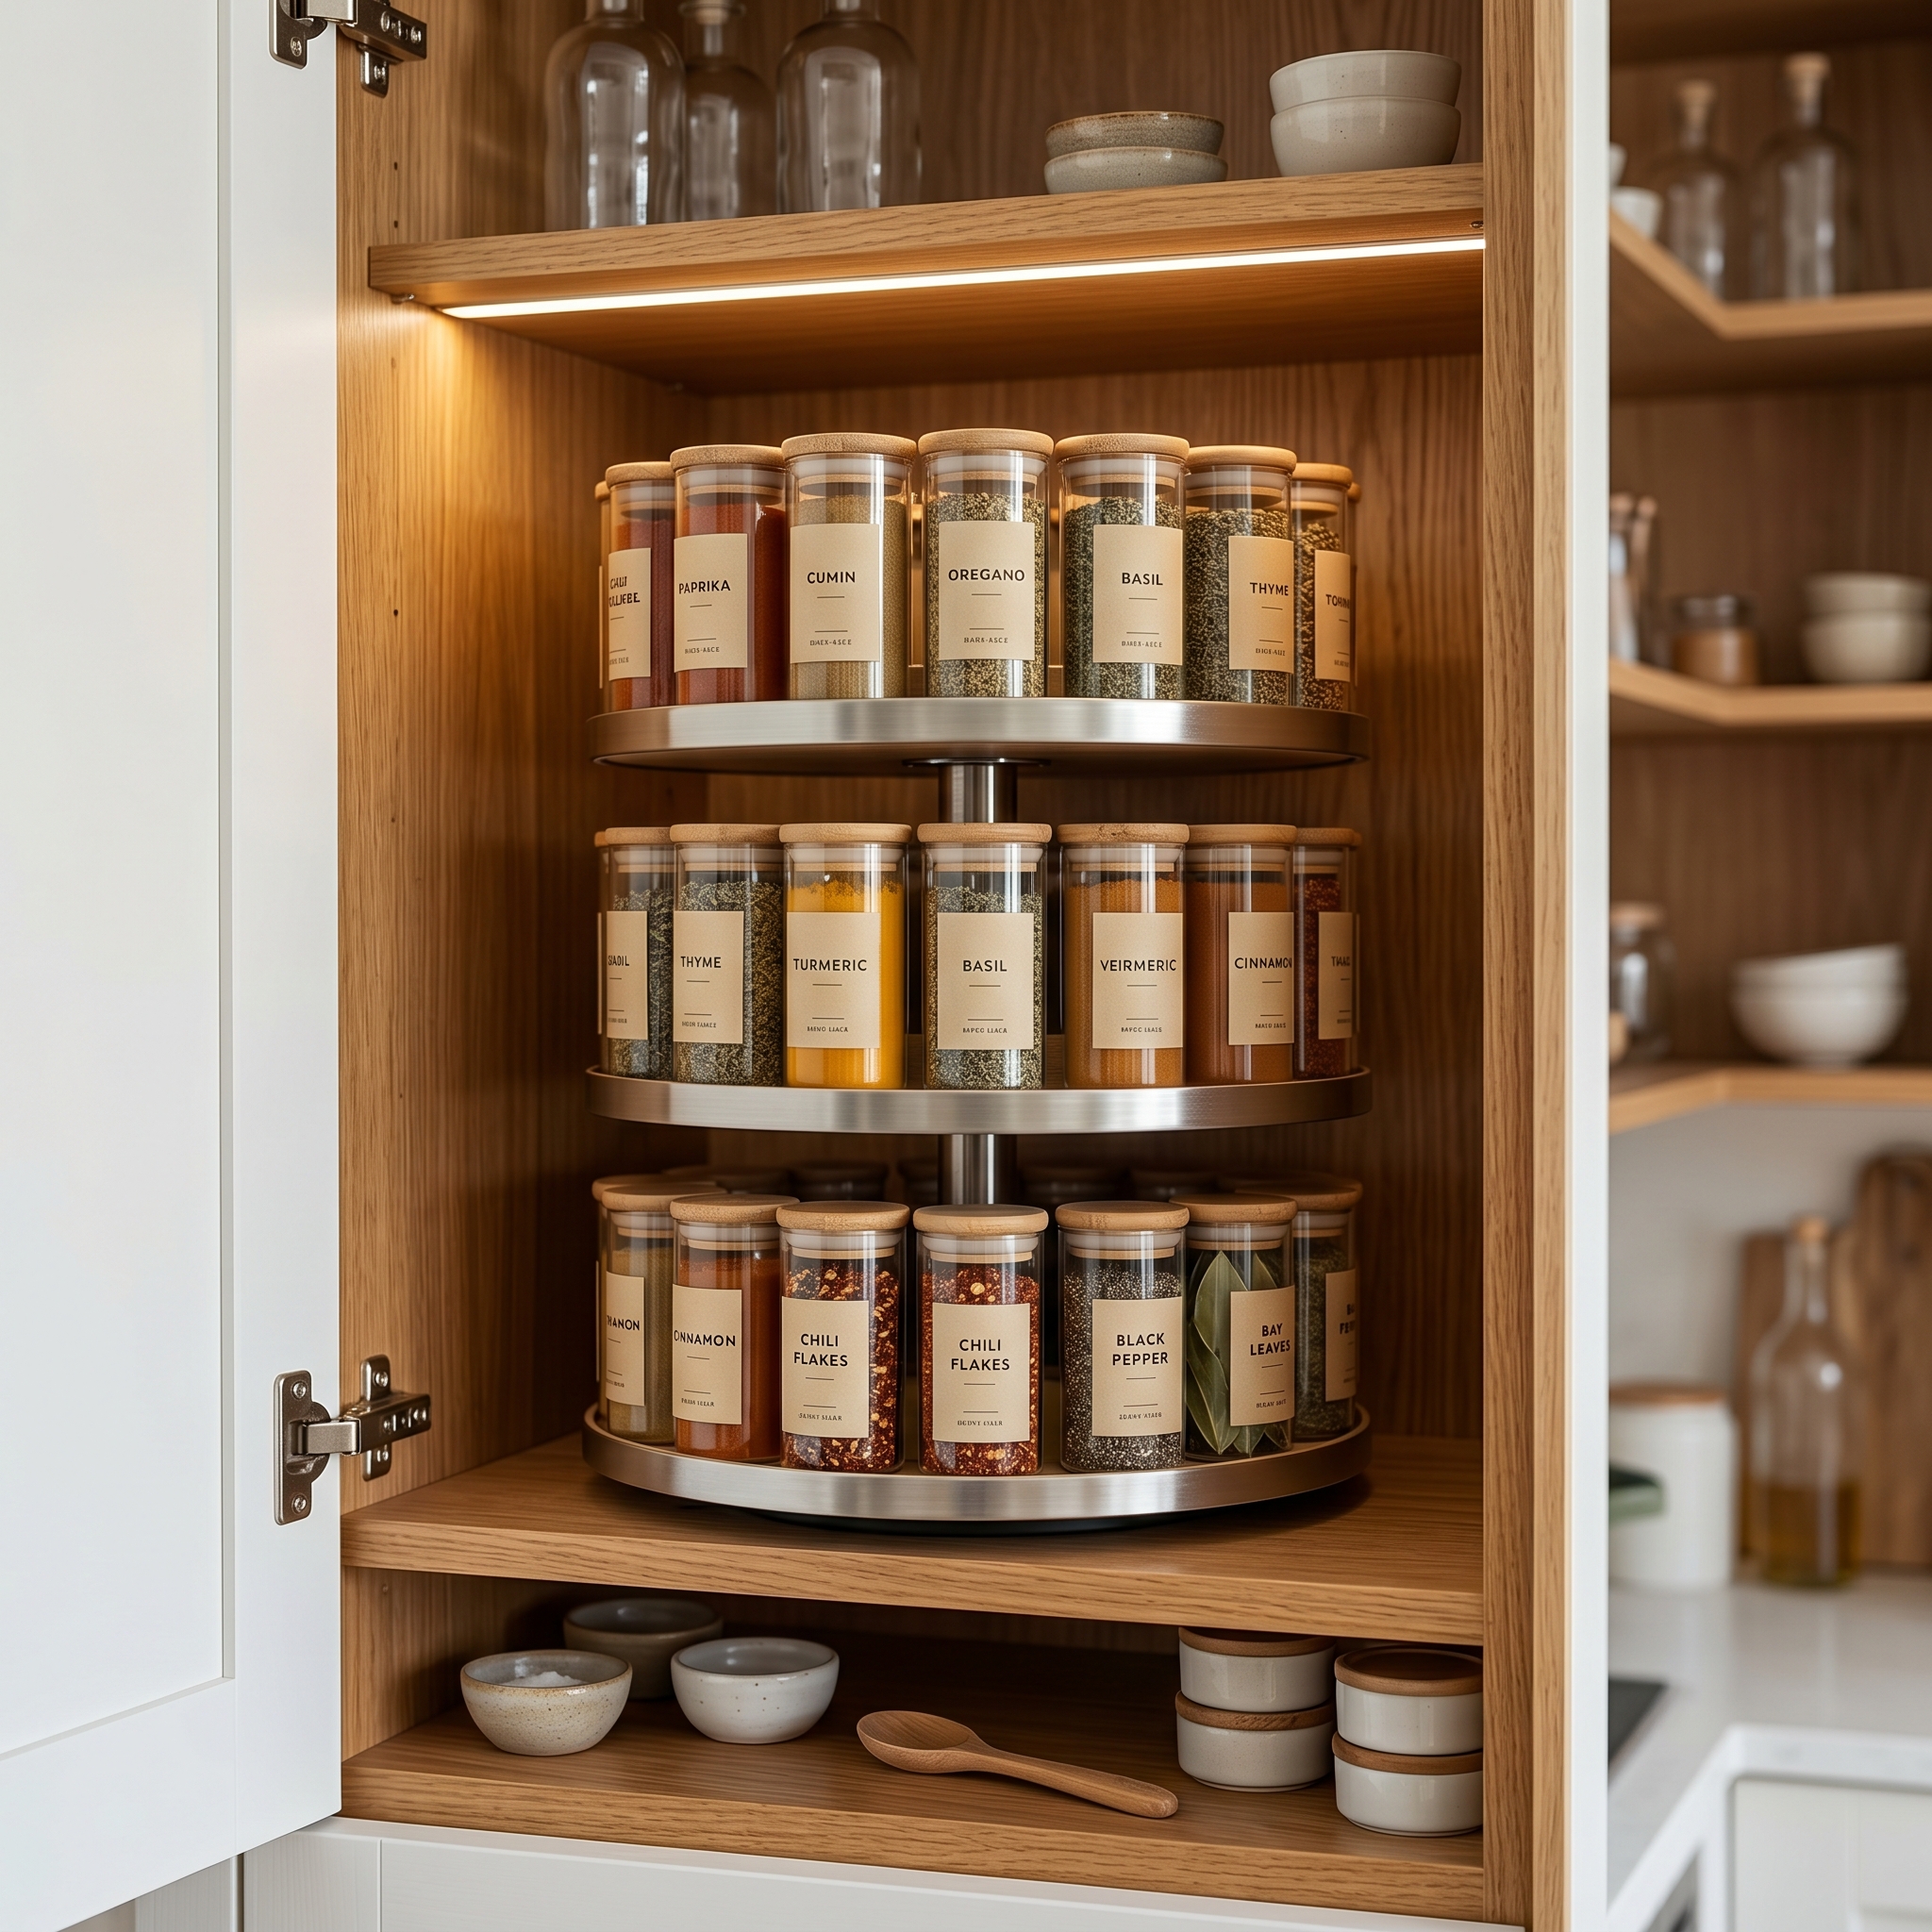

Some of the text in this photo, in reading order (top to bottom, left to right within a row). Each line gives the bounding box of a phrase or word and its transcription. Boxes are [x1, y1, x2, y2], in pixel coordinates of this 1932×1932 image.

[807, 571, 856, 585] CUMIN
[947, 568, 1025, 582] OREGANO
[1122, 572, 1164, 586] BASIL
[678, 579, 731, 594] PAPRIKA
[1249, 581, 1290, 597] THYME
[679, 956, 722, 969] THYME
[792, 958, 867, 972] TURMERIC
[962, 959, 1008, 973] BASIL
[1099, 958, 1177, 972] VEIRMERIC
[1261, 1322, 1284, 1338] BAY
[800, 1333, 839, 1347] CHILI
[958, 1339, 1001, 1352] CHILI
[1116, 1332, 1165, 1347] BLACK
[1250, 1340, 1291, 1356] LEAVES
[793, 1351, 848, 1367] FLAKES
[951, 1357, 1010, 1372] FLAKES
[1112, 1351, 1169, 1366] PEPPER
